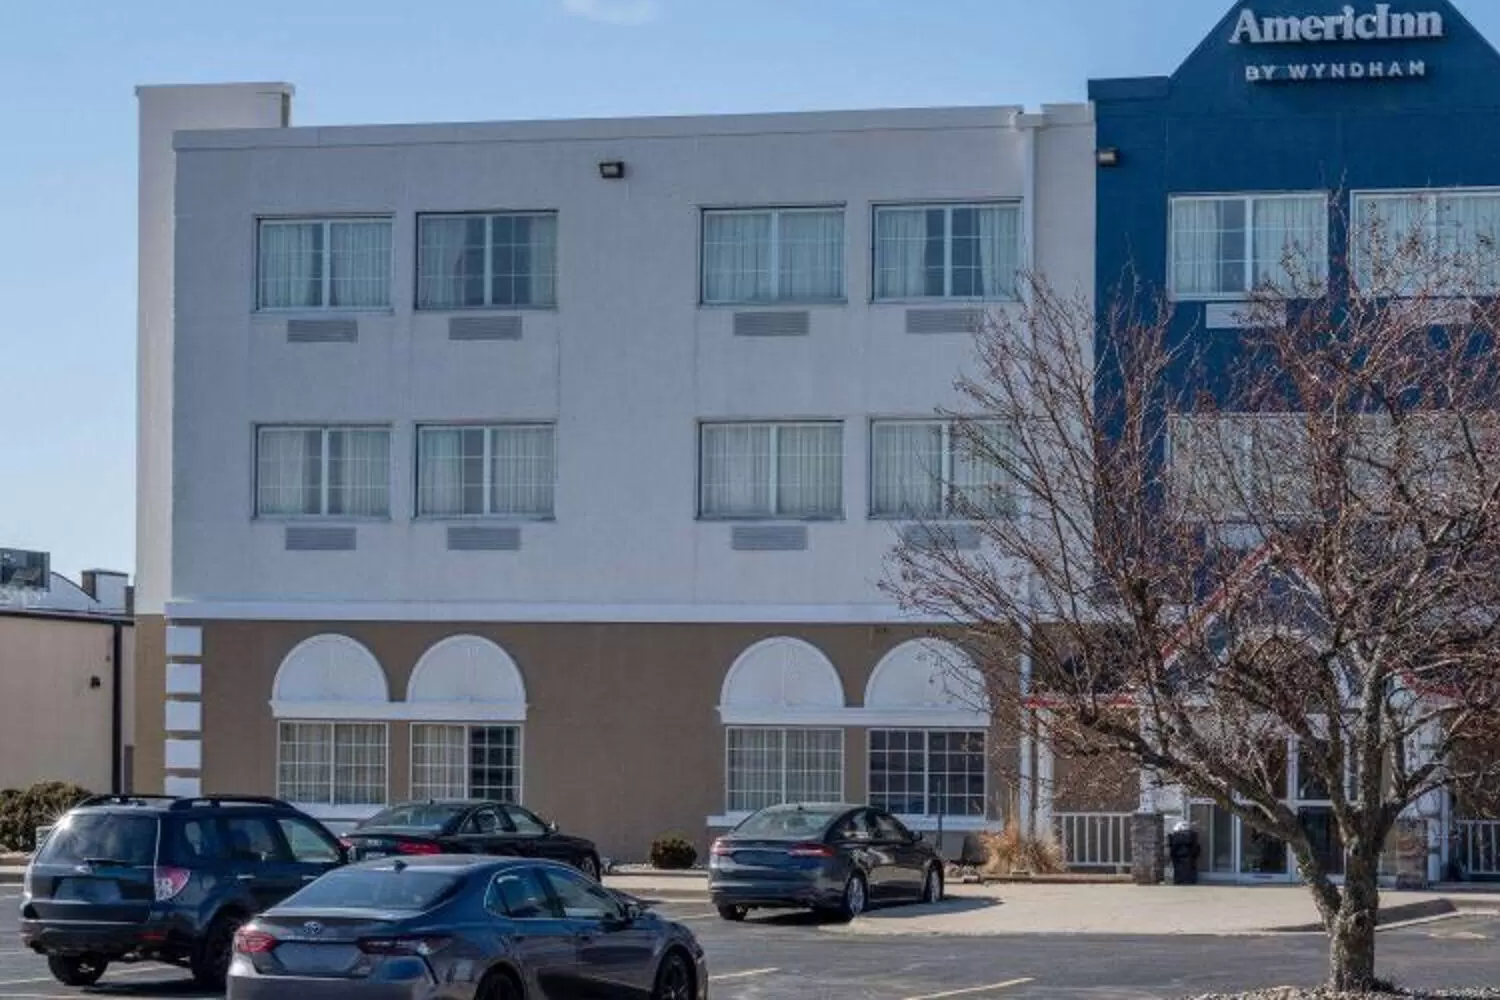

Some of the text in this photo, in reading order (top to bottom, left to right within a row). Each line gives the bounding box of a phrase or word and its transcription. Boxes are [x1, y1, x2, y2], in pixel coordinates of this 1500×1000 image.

[1229, 3, 1444, 44] AmericInn
[1245, 60, 1426, 82] BY WYNDHAM
